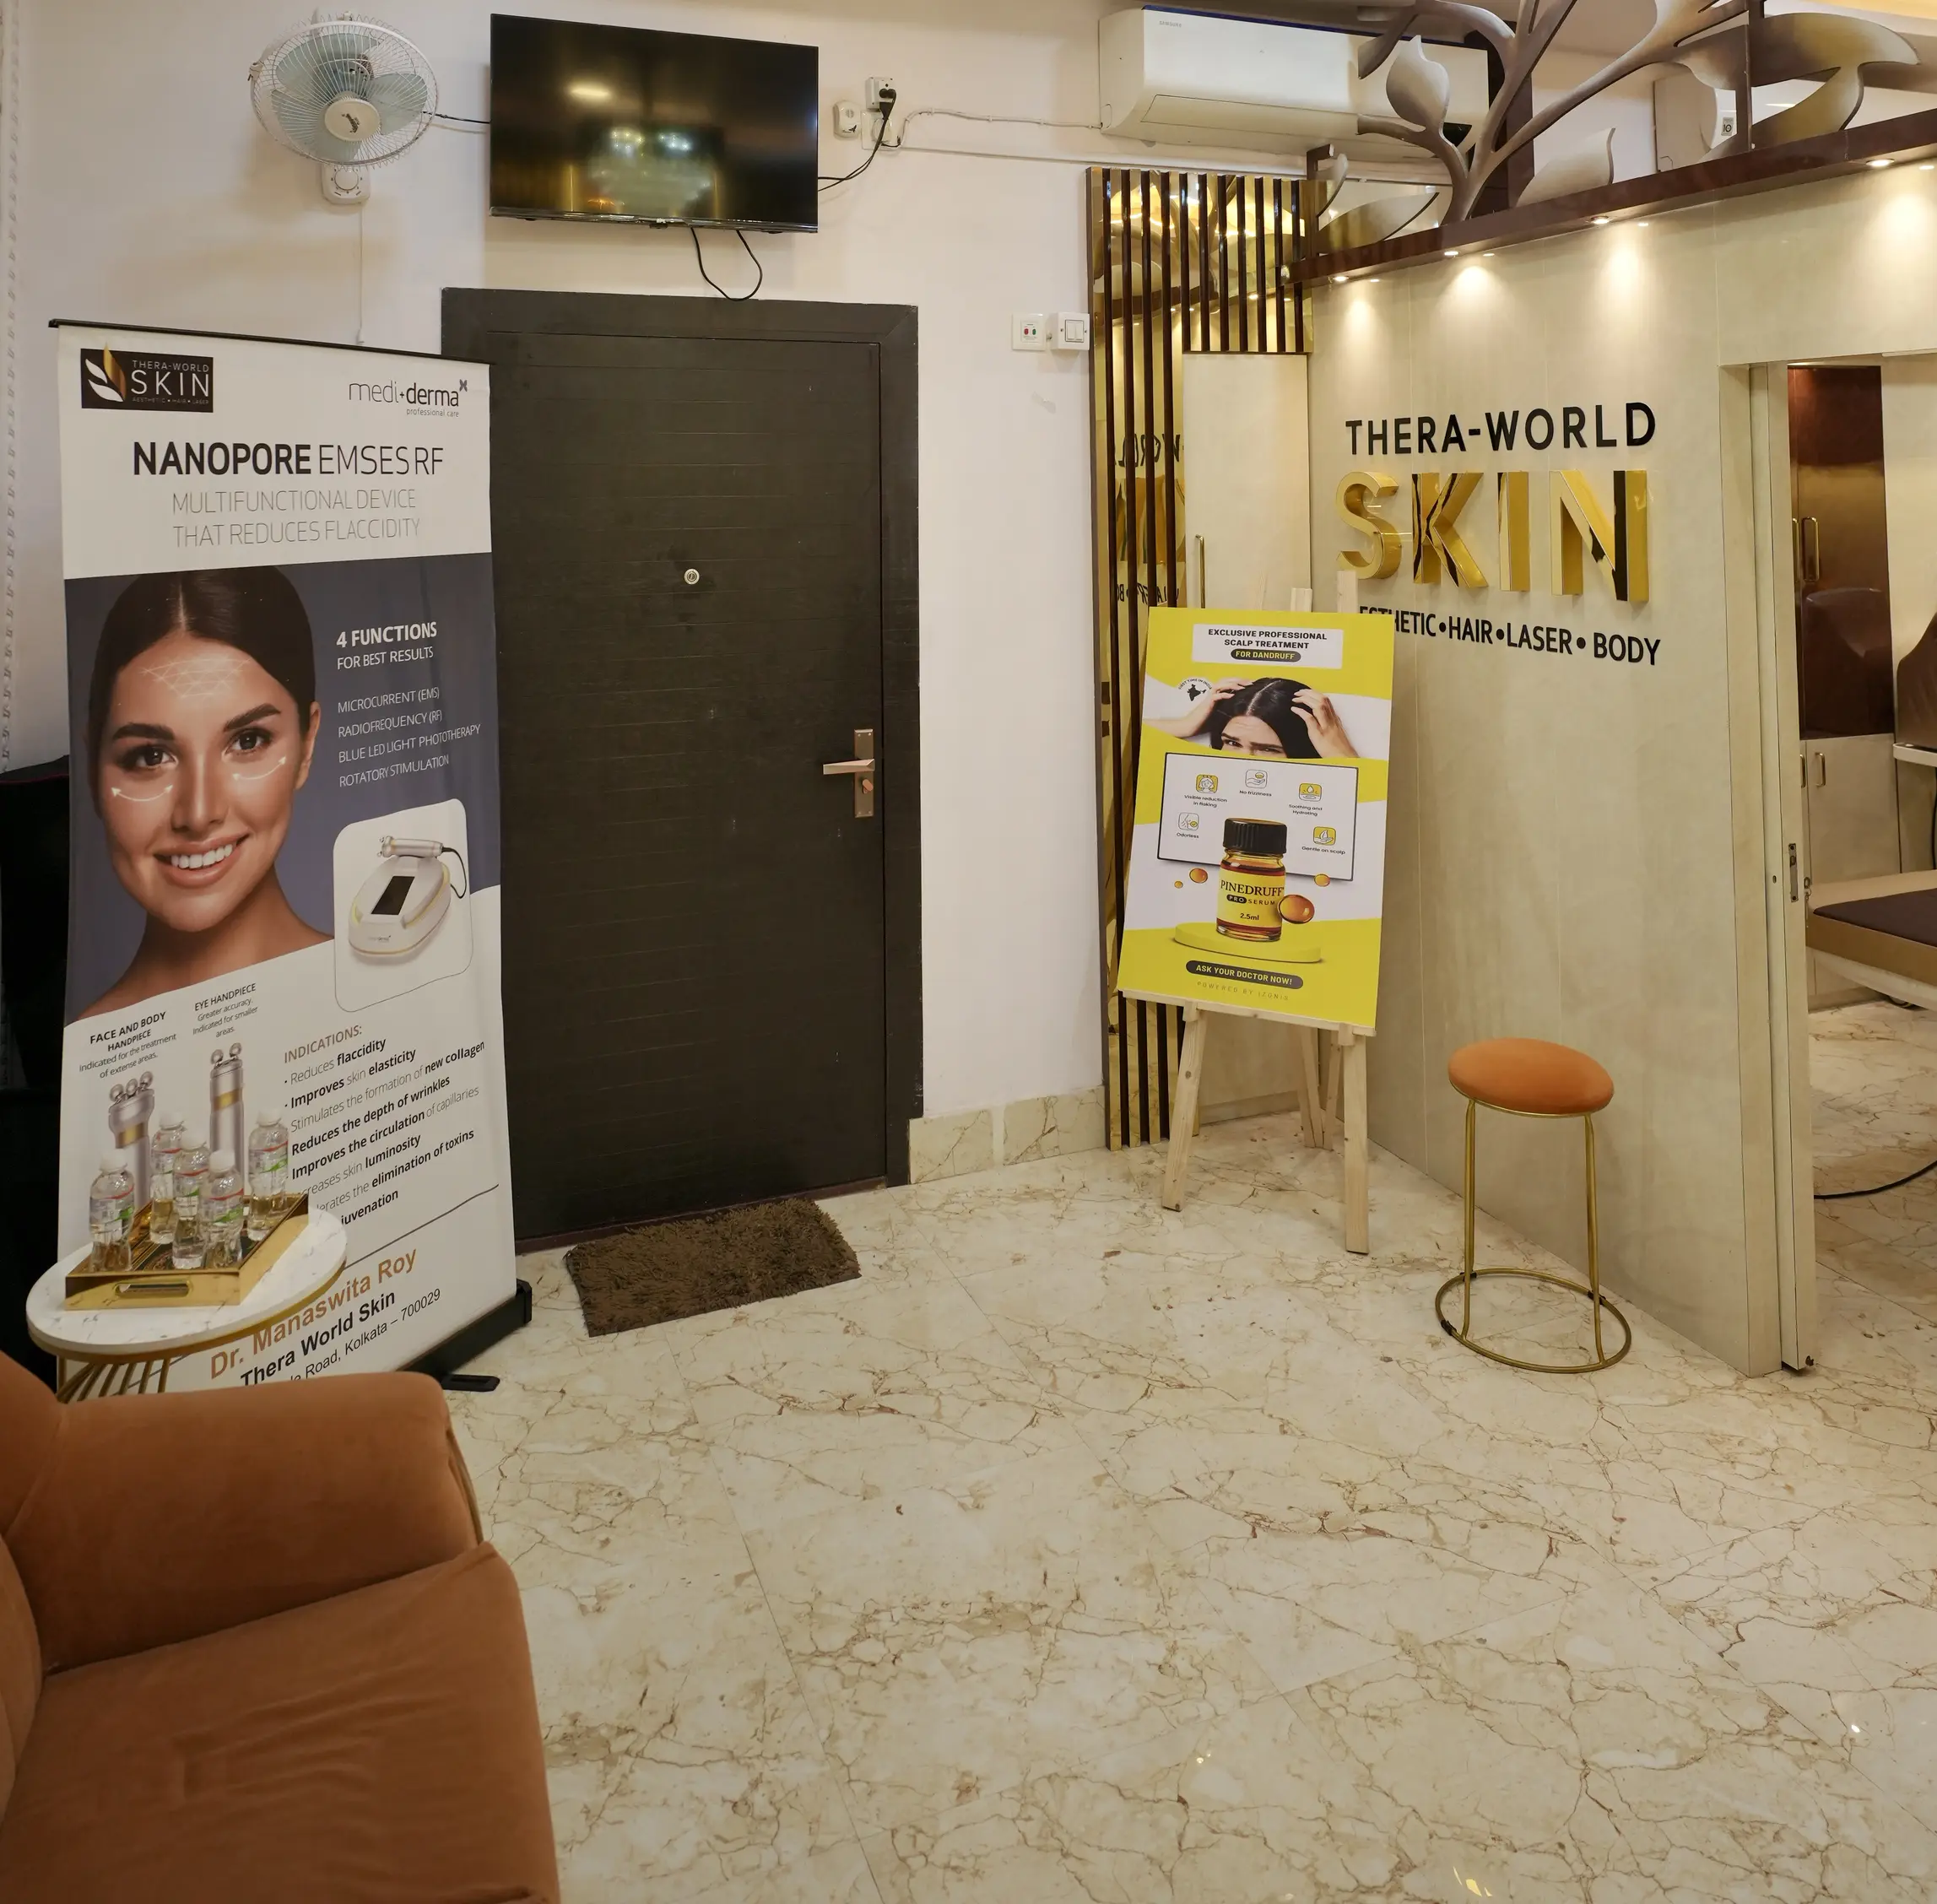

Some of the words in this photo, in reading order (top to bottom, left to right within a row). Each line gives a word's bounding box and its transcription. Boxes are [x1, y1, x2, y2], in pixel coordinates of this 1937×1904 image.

[133, 360, 209, 371] THERA-WORLD
[131, 370, 209, 397] SKIN
[407, 408, 445, 416] professional
[1345, 402, 1656, 455] THERA-WORLD
[133, 441, 311, 475] NANOPORE
[319, 444, 409, 474] EMSES
[416, 446, 443, 475] RF
[173, 490, 354, 515] MULTIFUNCTIONAL
[358, 489, 416, 509] DEVICE
[174, 525, 222, 547] THAT
[230, 521, 320, 545] REDUCES
[326, 518, 421, 540] FLACCIDITY
[1336, 468, 1649, 602] SKIN
[337, 631, 347, 647] 4
[352, 622, 437, 646] FUNCTIONS
[1209, 629, 1257, 638] EXCLUSIVE
[1259, 631, 1327, 640] PROFESSIONAL
[1256, 641, 1309, 649] TREATMENT
[1449, 616, 1493, 645] HAIR
[1507, 624, 1572, 655] LASER
[1593, 632, 1661, 665] BODY
[337, 657, 360, 669] FOR
[363, 652, 387, 667] BEST
[390, 646, 434, 663] RESULTS
[1253, 652, 1295, 660] DANDRUFF
[338, 690, 415, 713] MICROCURRENT
[418, 687, 440, 701] (EMS)
[338, 713, 428, 738] RADIOFREQUENCY
[429, 710, 442, 724] (RF)
[339, 747, 365, 763] BLUE
[369, 744, 385, 758] LED
[387, 738, 416, 753] LIGHT
[419, 724, 480, 747] PHOTOTHERAPY
[339, 767, 388, 787] ROTATORY
[389, 755, 449, 776] STIMULATION
[1197, 982, 1238, 993] POWERED
[1214, 967, 1235, 976] YOUR
[1236, 971, 1268, 982] DOCTOR
[1270, 976, 1292, 985] NOW!
[194, 1000, 208, 1011] EYE
[211, 983, 256, 1004] HANDPIECE
[197, 1007, 222, 1021] Greater
[223, 999, 253, 1014] accuracy.
[90, 1030, 116, 1044] FACE
[118, 1022, 138, 1036] AND
[140, 1011, 166, 1028] BODY
[192, 1018, 222, 1035] Indicated
[224, 1015, 233, 1024] for
[235, 1006, 258, 1020] smaller
[216, 1026, 235, 1038] areas.
[79, 1055, 116, 1072] Indicated
[118, 1049, 128, 1061] for
[130, 1046, 139, 1057] the
[141, 1033, 176, 1052] treatment
[107, 1029, 151, 1052] HANDPIECE
[284, 1025, 362, 1063] INDICATIONS:
[100, 1069, 109, 1079] of
[110, 1061, 137, 1075] extense
[138, 1052, 158, 1064] areas.
[291, 1059, 334, 1085] Reduces
[337, 1038, 386, 1066] flaccidity
[291, 1078, 344, 1109] Improves
[347, 1068, 366, 1085] skin
[368, 1048, 416, 1075] elasticity
[291, 1103, 344, 1133] Stimulates
[347, 1095, 363, 1107] the
[365, 1074, 411, 1099] formation
[414, 1068, 424, 1080] of
[425, 1059, 443, 1074] new
[446, 1041, 484, 1063] collagen
[291, 1128, 339, 1156] Reduces
[342, 1119, 360, 1133] the
[364, 1102, 394, 1125] depth
[398, 1095, 408, 1108] of
[410, 1076, 450, 1103] wrinkles
[292, 1147, 346, 1181] Improves
[349, 1139, 366, 1153] the
[370, 1111, 425, 1144] circulation
[426, 1107, 435, 1118] of
[436, 1086, 479, 1112] capillaries
[303, 1175, 340, 1195] creases
[343, 1161, 363, 1179] skin
[365, 1134, 421, 1169] luminosity
[353, 1182, 369, 1198] the
[371, 1153, 430, 1187] elimination
[434, 1143, 444, 1157] of
[446, 1129, 474, 1150] toxins
[211, 1350, 244, 1379] Dr.
[253, 1275, 371, 1355] Manaswita
[378, 1248, 416, 1284] Roy
[241, 1351, 295, 1386] Thera
[300, 1313, 353, 1355] World
[359, 1290, 395, 1323] Skin
[306, 1350, 341, 1382] Road,
[345, 1324, 387, 1359] Kolkata
[401, 1288, 441, 1322] 700029
